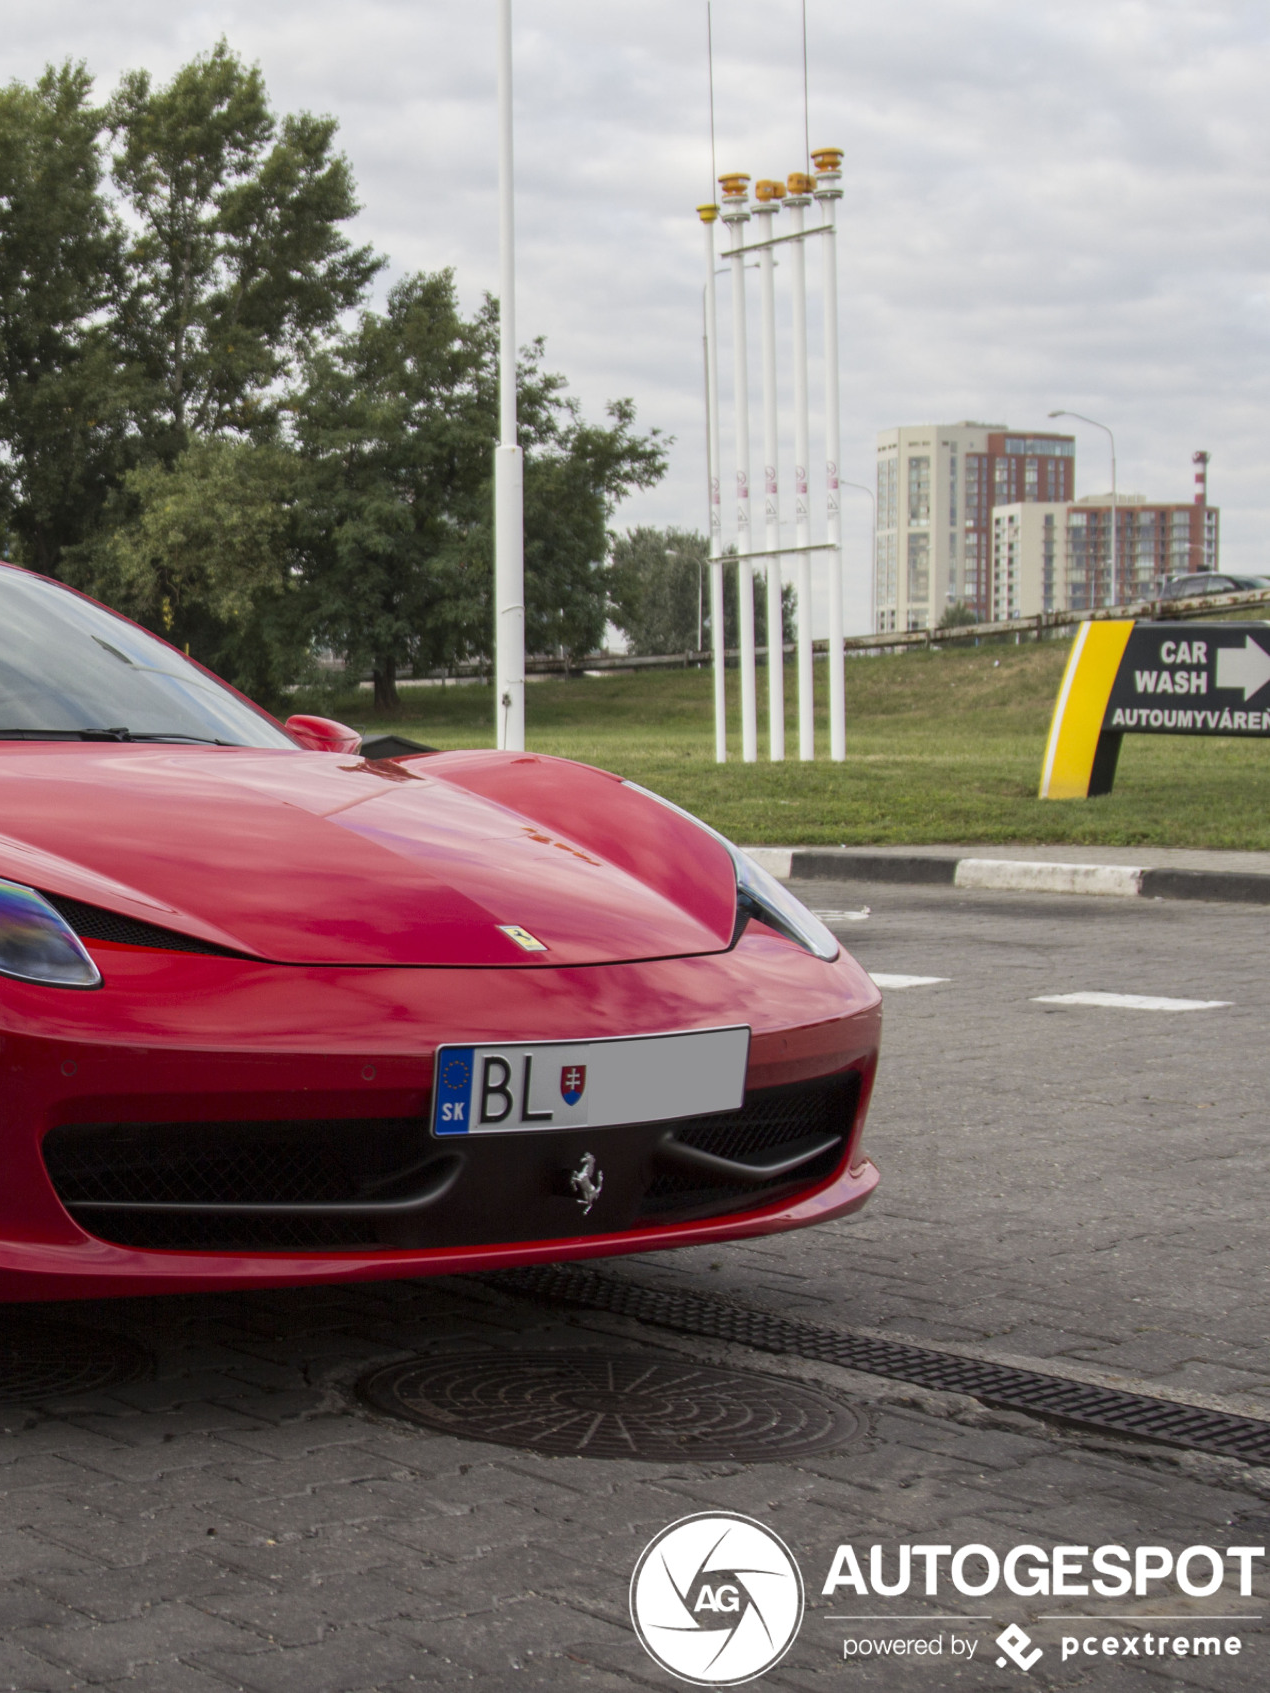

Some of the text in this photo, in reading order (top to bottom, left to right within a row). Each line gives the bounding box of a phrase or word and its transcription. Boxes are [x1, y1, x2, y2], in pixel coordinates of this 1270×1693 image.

[1160, 640, 1208, 664] CAR
[1134, 670, 1209, 694] WASH
[479, 1053, 554, 1124] BL
[441, 1102, 465, 1122] SK
